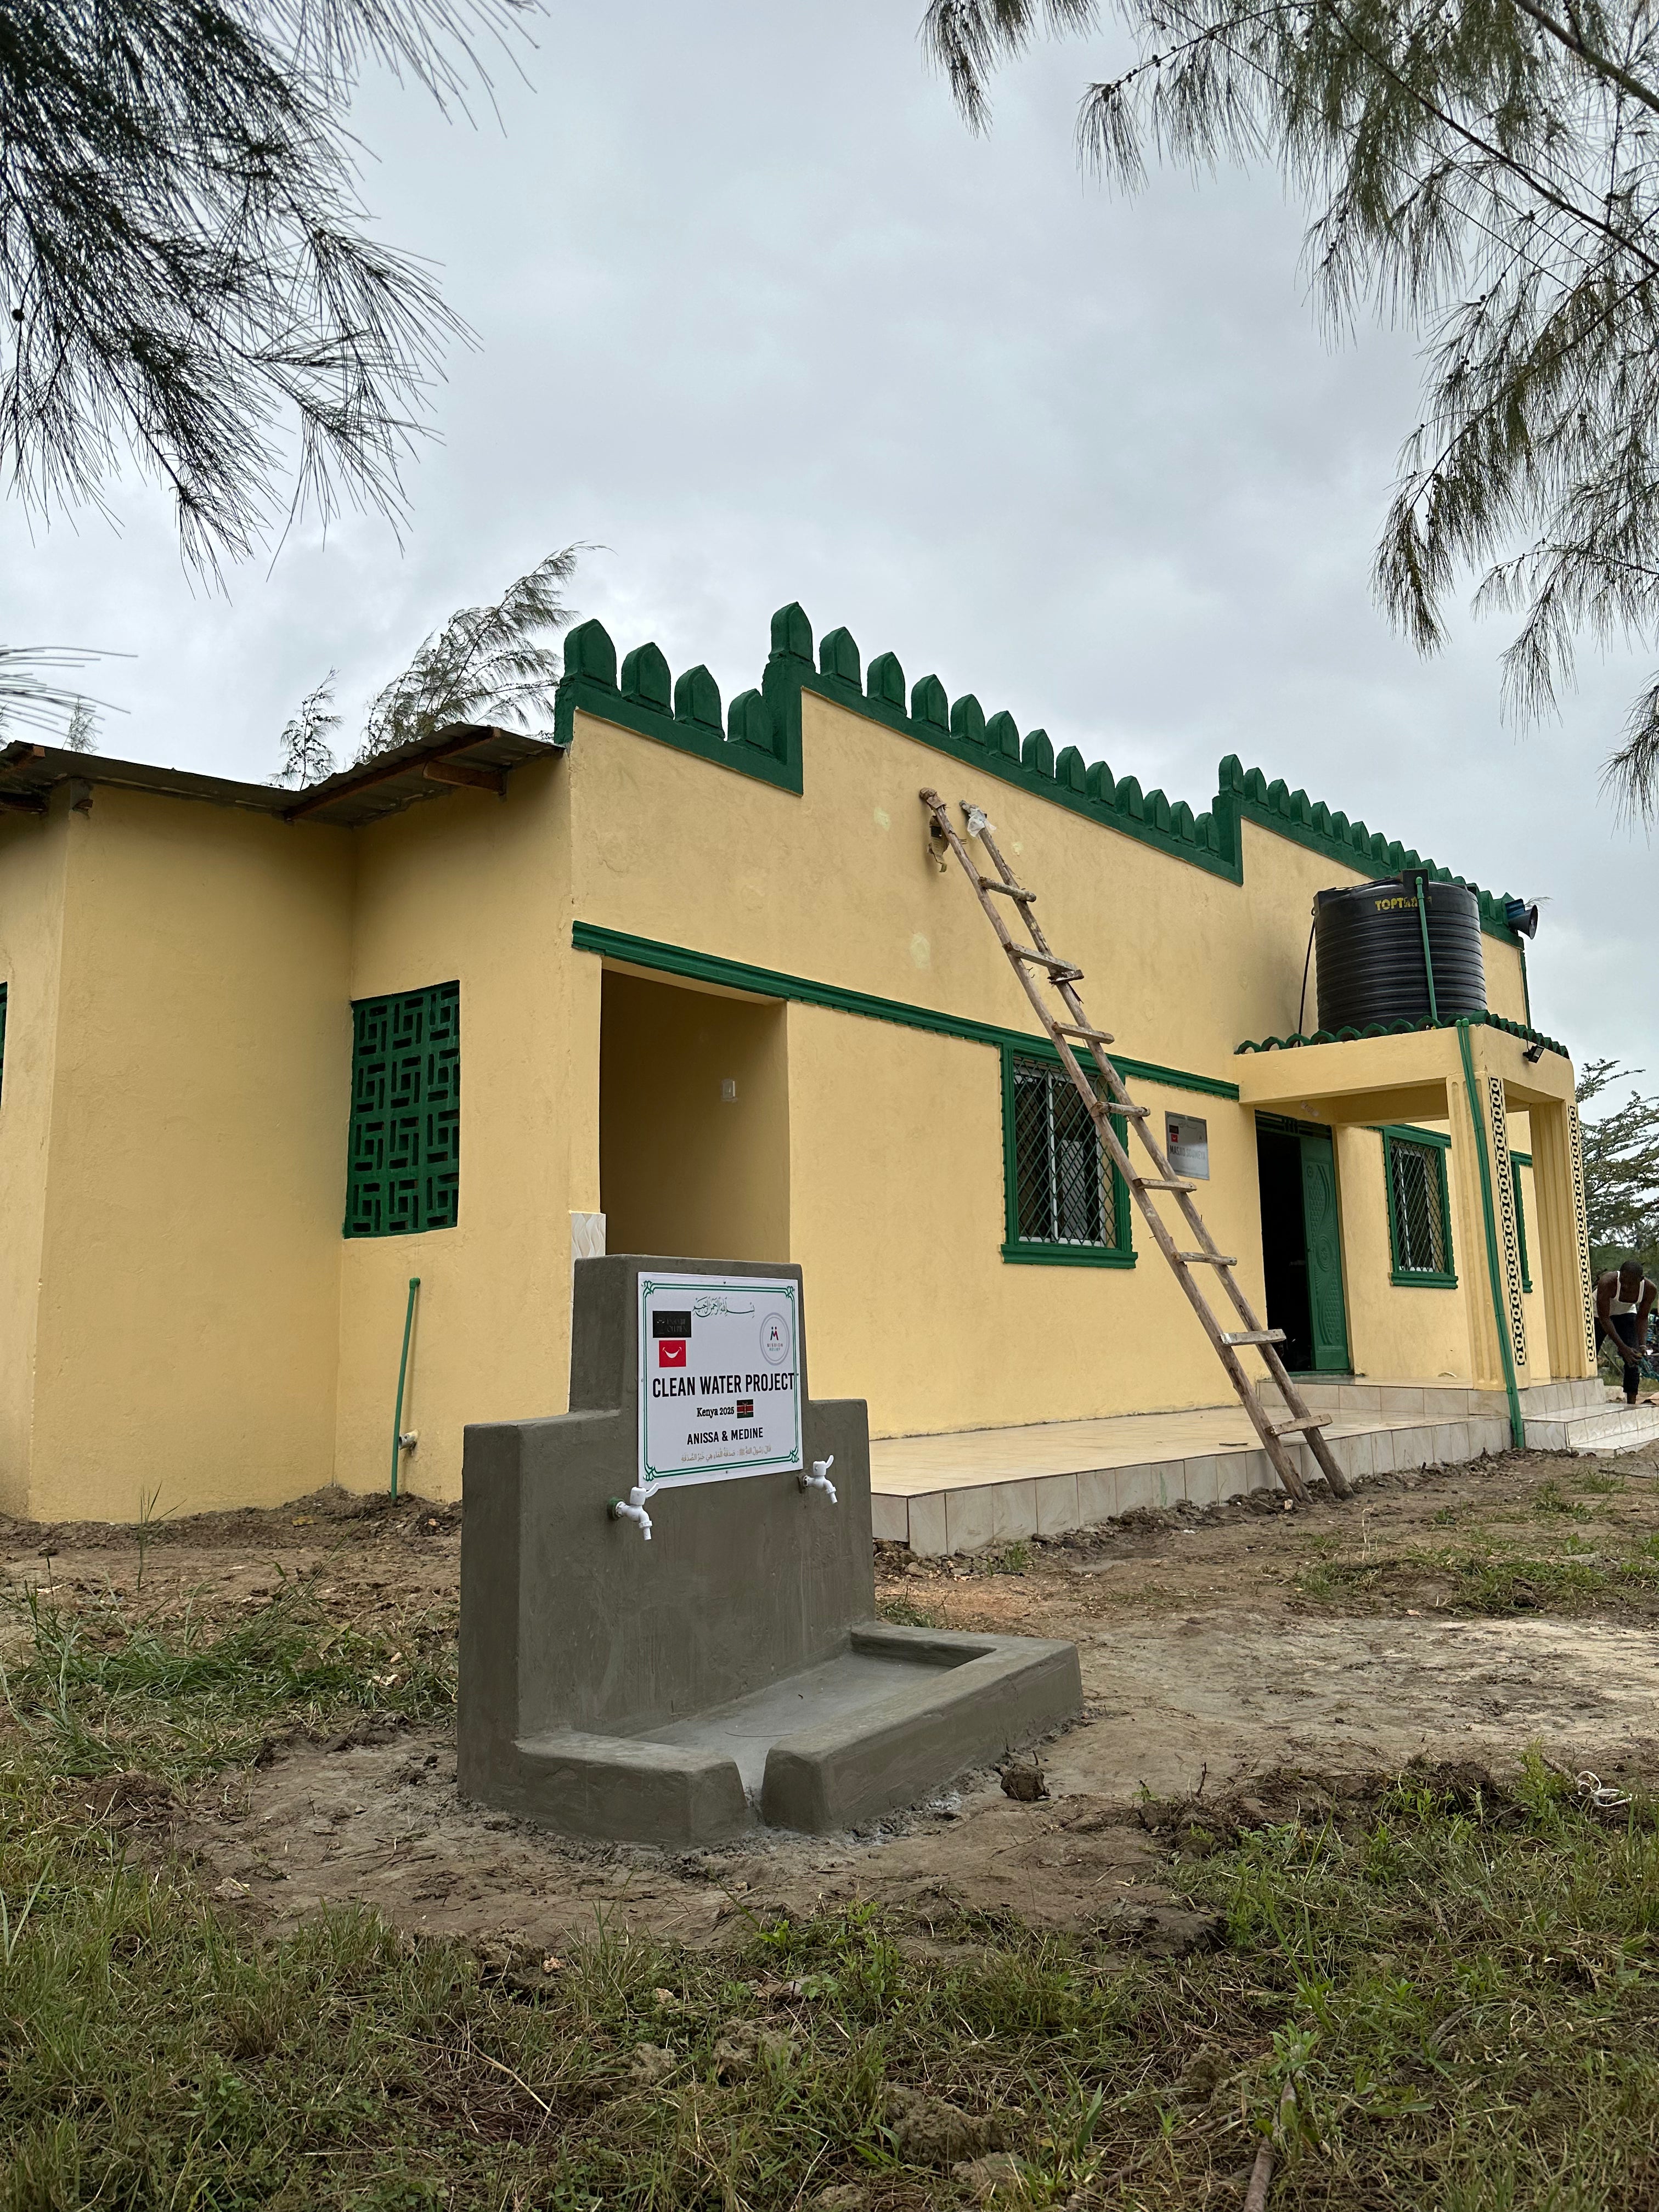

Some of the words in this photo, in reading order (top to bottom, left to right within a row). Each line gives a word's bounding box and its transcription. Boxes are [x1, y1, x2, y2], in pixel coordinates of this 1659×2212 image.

[1170, 1145, 1185, 1156] MASJID
[653, 1376, 695, 1397] CLEAN
[700, 1375, 741, 1395] WATER
[746, 1373, 794, 1392] PROJECT
[697, 1407, 718, 1418] Kenya
[719, 1407, 734, 1415] 2025
[687, 1431, 719, 1445] ANISSA
[721, 1431, 729, 1442] &
[731, 1427, 763, 1441] MEDINE
